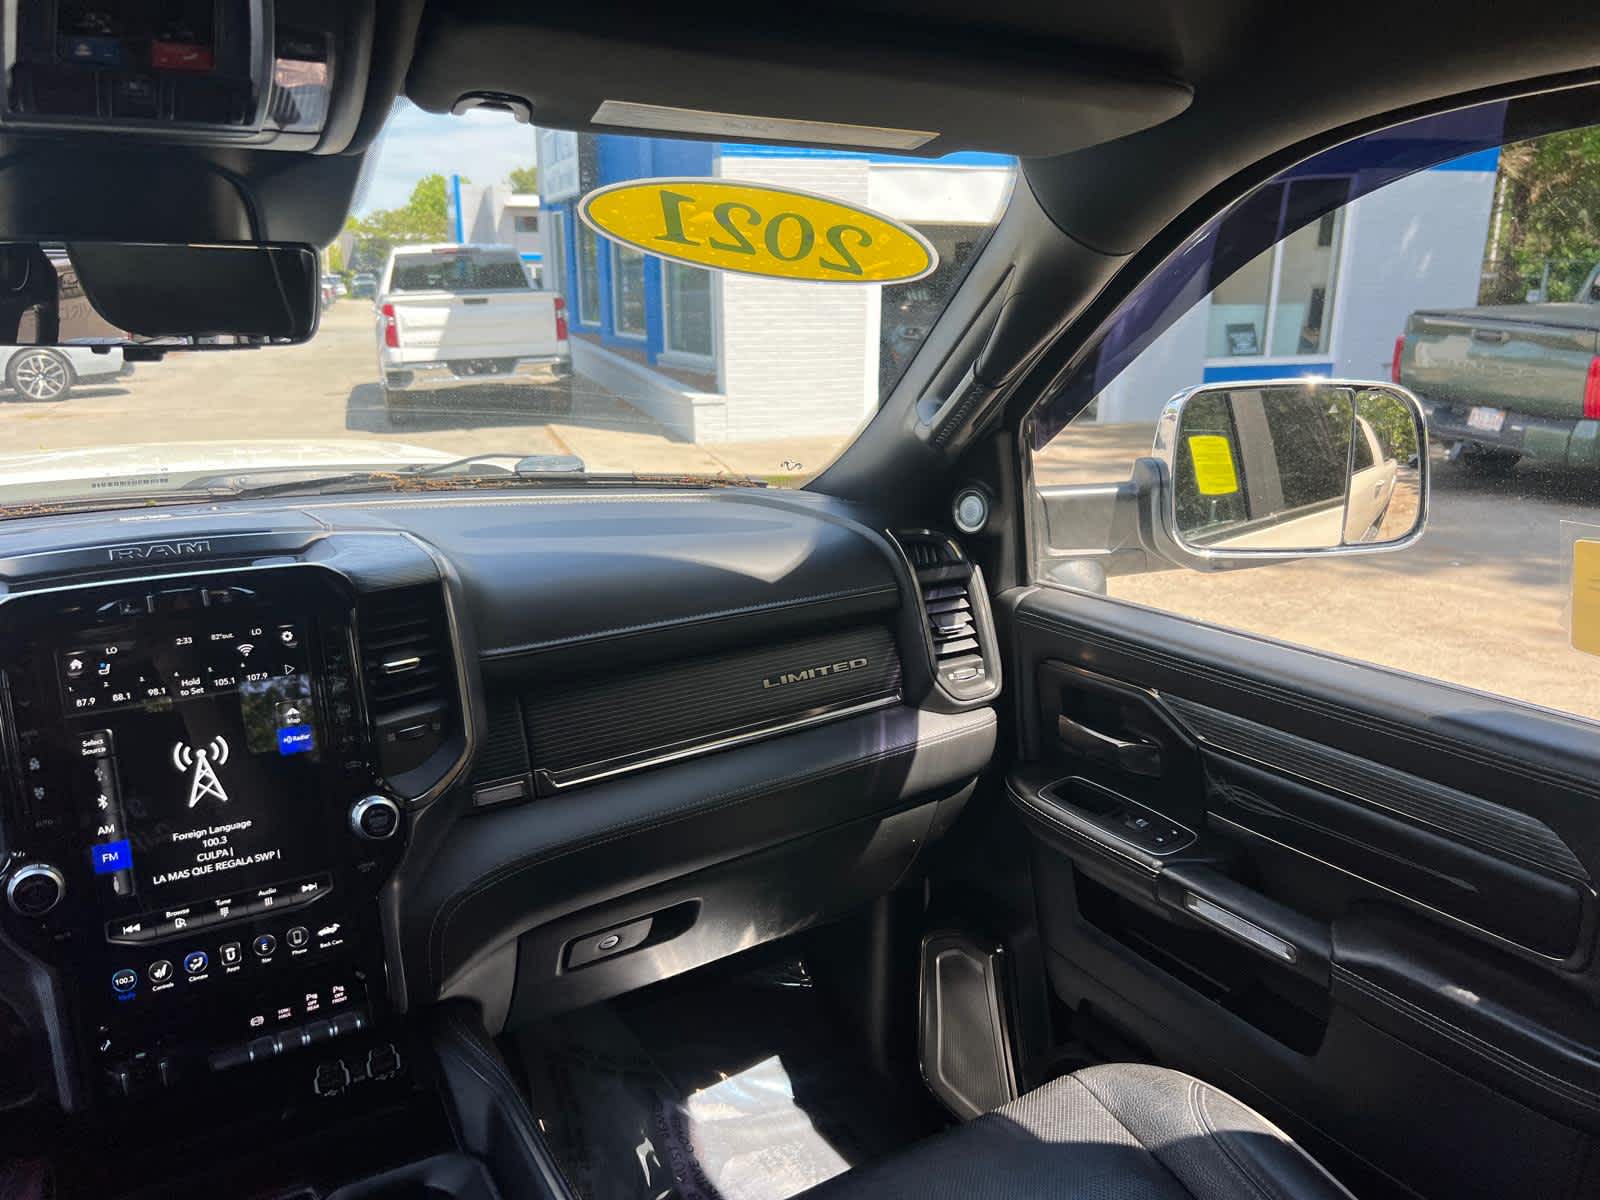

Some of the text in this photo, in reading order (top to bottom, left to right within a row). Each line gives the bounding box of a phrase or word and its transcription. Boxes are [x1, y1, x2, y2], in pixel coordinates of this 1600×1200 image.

[108, 540, 211, 561] RAM
[251, 628, 262, 636] LO
[176, 637, 193, 645] 2:33
[105, 646, 118, 655] LO
[247, 672, 268, 681] 107.9
[763, 658, 868, 689] LIMITED
[181, 677, 201, 687] Hold
[214, 677, 236, 687] 105.1
[147, 687, 166, 696] 98.1
[180, 687, 205, 696] to Set
[76, 697, 96, 707] 87.9
[112, 692, 131, 702] 88.1
[82, 739, 104, 747] Select
[82, 747, 106, 756] Source
[97, 823, 115, 836] AM
[172, 820, 252, 842] Foreign Language
[202, 836, 228, 848] 100.3
[102, 852, 119, 864] FM
[196, 848, 229, 862] CULPA
[152, 874, 167, 885] LA
[167, 869, 191, 882] MAS
[191, 863, 214, 876] QUE
[215, 856, 254, 872] REGALA
[254, 850, 275, 863] SWP
[258, 887, 277, 896] Audio
[165, 908, 190, 918] Browse
[115, 975, 135, 986] 100.3
